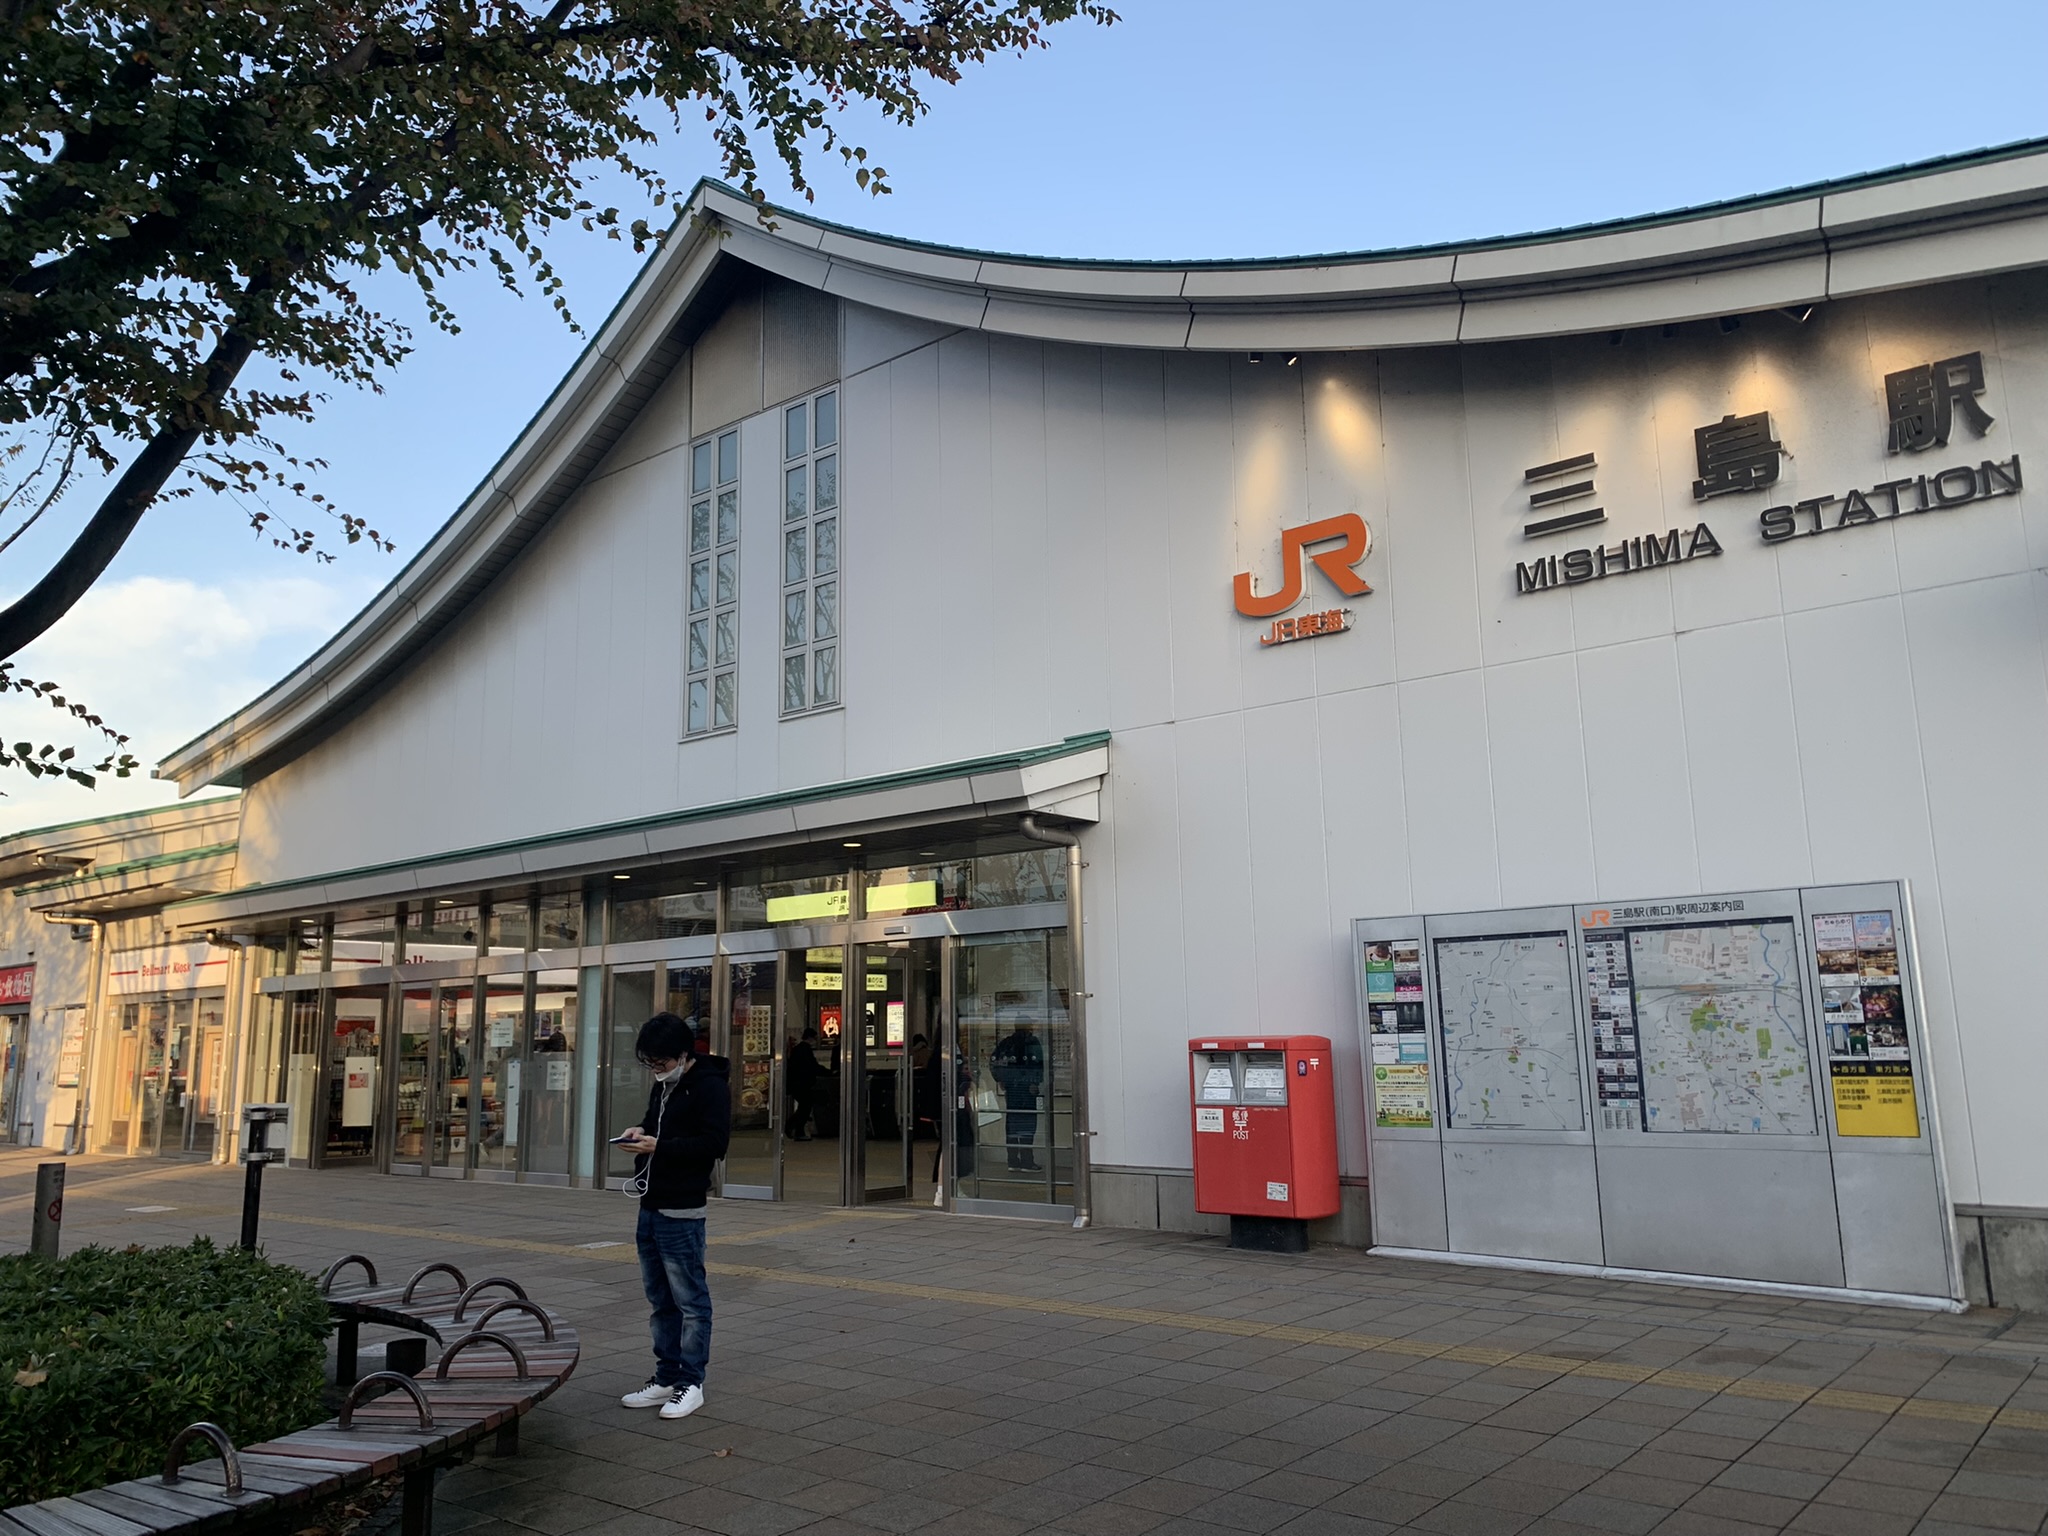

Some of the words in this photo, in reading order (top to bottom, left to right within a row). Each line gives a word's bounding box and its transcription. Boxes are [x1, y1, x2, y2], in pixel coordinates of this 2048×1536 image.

[1523, 351, 1996, 537] 三島駅
[1516, 523, 1724, 593] MISHIMA
[1760, 455, 2023, 543] STATION
[1233, 513, 1374, 618] JR
[1260, 608, 1344, 646] JR東海
[1581, 909, 1611, 927] JR
[1612, 900, 1745, 920] 三島駅(南口)駅周辺案内図
[142, 964, 170, 977] Bellmart
[173, 962, 191, 974] Kiosk
[1232, 1110, 1249, 1122] 郵便
[1233, 1130, 1249, 1140] POST
